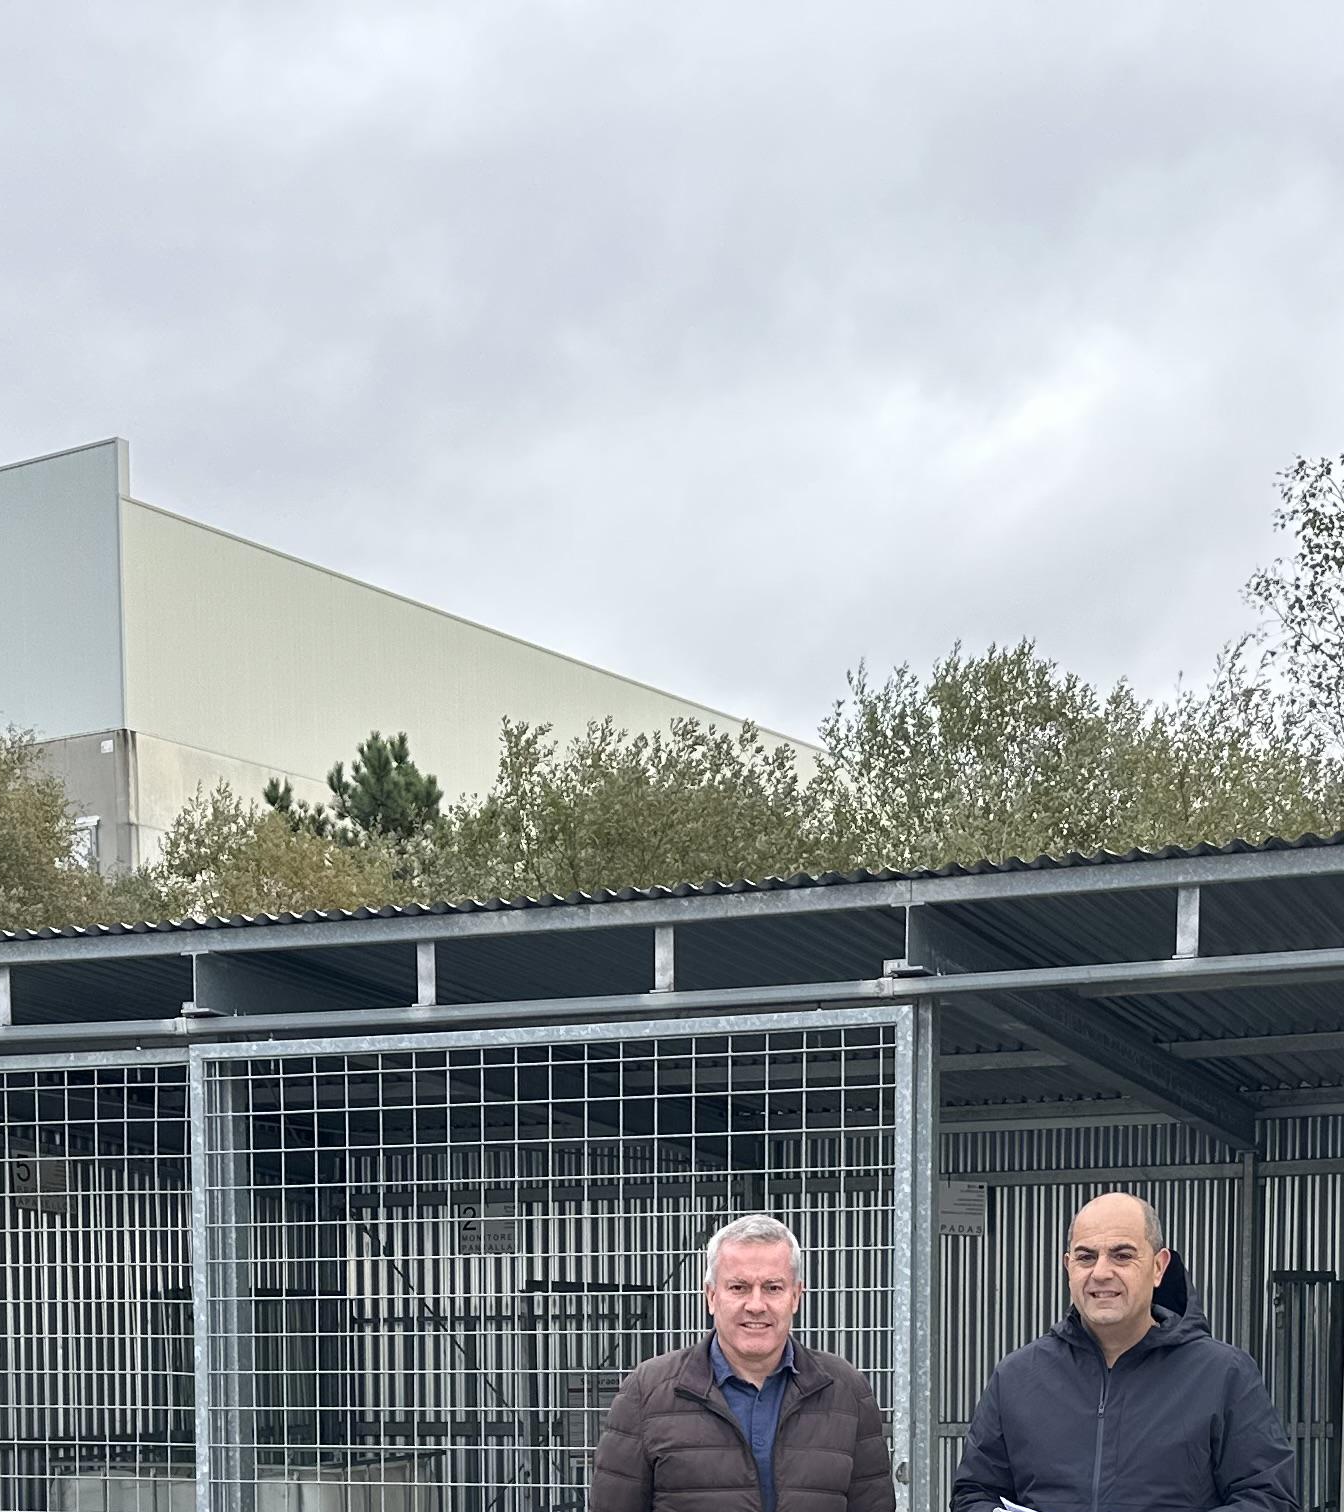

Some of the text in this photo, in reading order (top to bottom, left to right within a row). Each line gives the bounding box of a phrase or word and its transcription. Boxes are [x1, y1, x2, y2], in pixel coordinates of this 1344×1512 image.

[16, 1153, 31, 1181] 5
[462, 1206, 477, 1231] 2
[940, 1224, 982, 1233] PADAS
[462, 1233, 518, 1242] MONTORE
